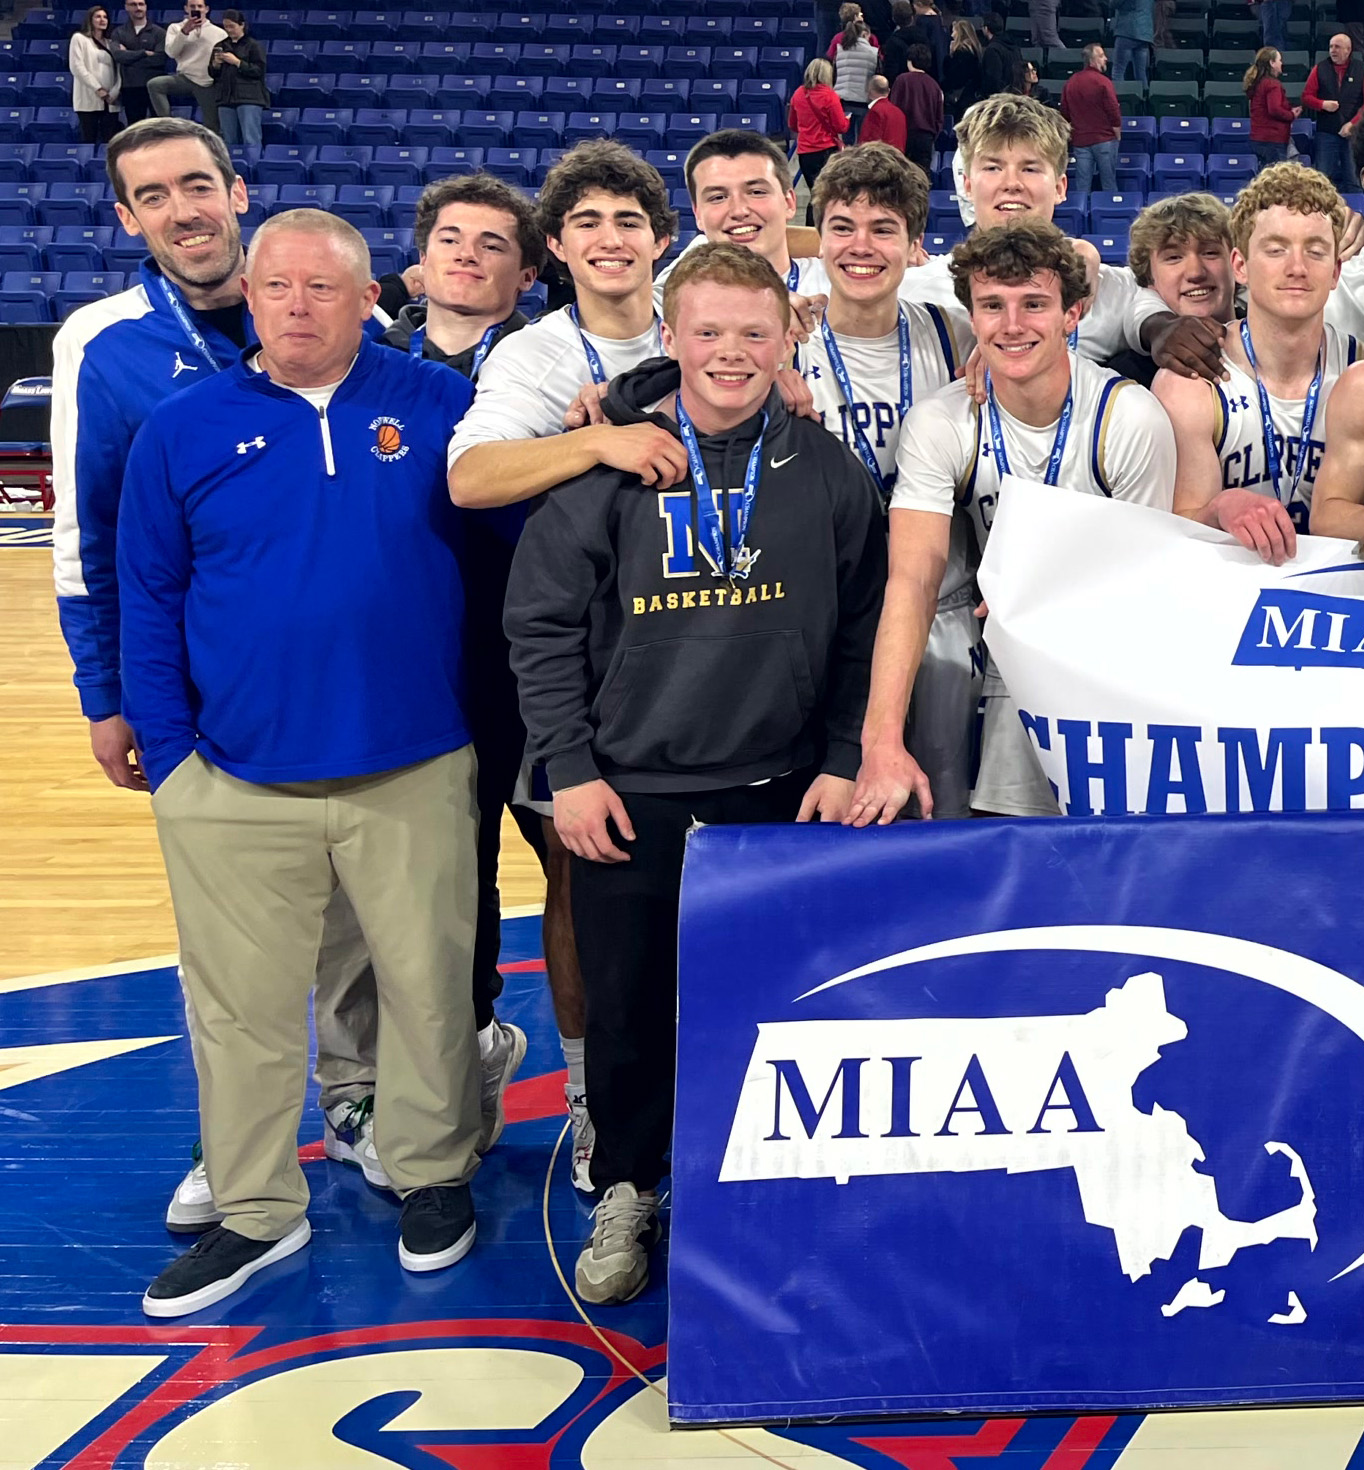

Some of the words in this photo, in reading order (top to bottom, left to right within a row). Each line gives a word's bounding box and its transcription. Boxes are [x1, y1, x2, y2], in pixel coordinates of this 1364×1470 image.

[370, 445, 410, 463] CLIPPERS
[658, 488, 748, 578] N
[633, 582, 786, 614] BASKETBALL
[764, 1051, 1105, 1140] MIAA
